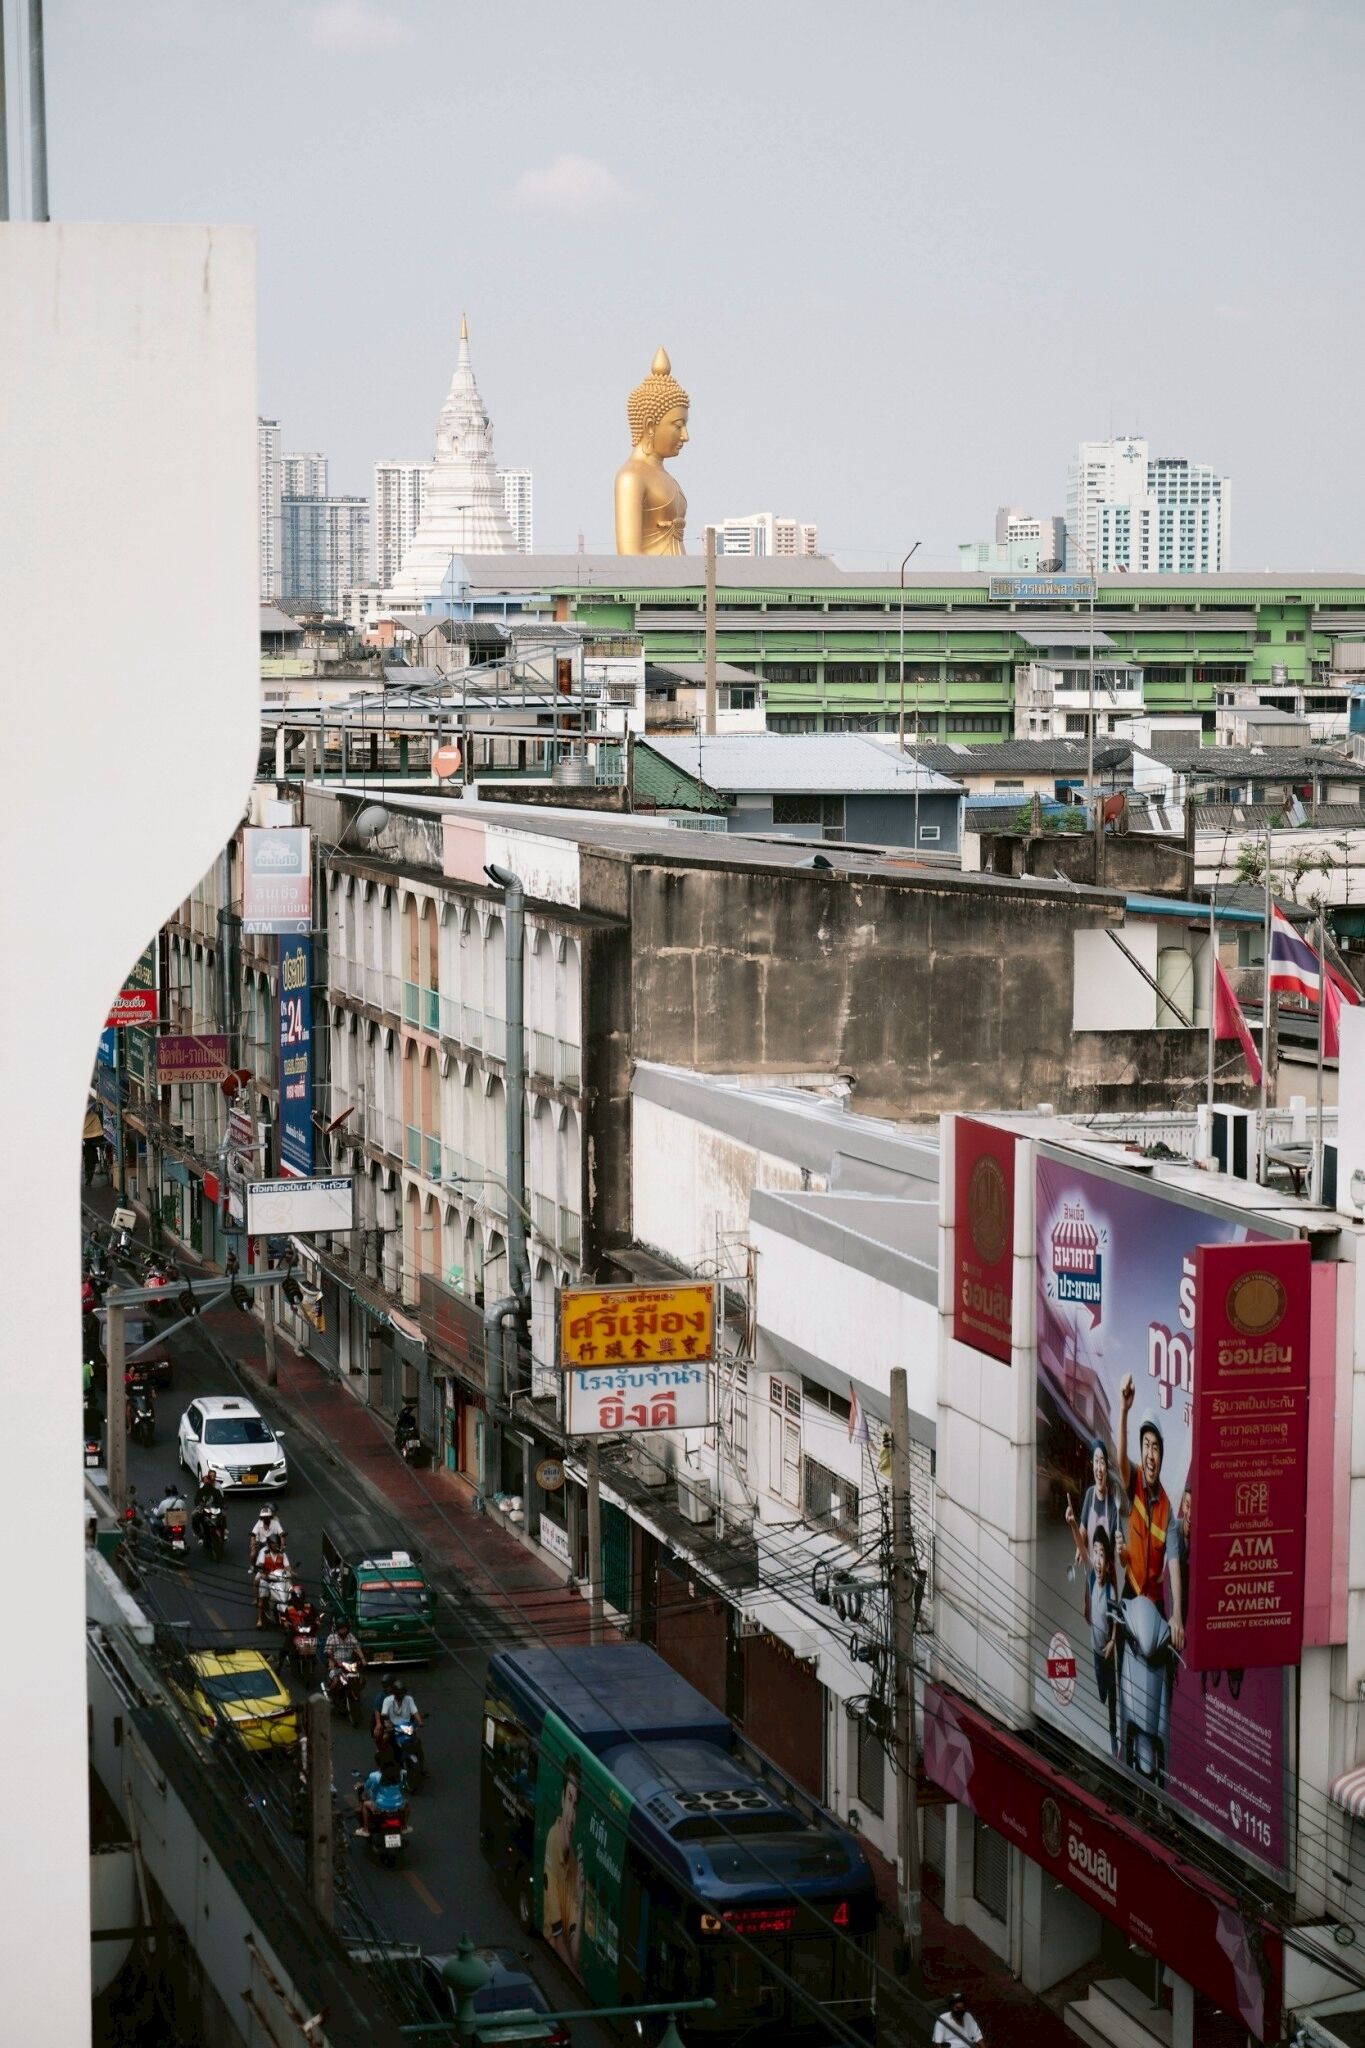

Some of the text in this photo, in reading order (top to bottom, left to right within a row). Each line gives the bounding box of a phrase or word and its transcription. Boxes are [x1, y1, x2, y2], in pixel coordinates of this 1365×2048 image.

[246, 922, 273, 932] ATM
[288, 999, 303, 1043] 24
[160, 1068, 225, 1081] 02-4663206
[1054, 1245, 1095, 1270] ธนาคาร
[1059, 1273, 1101, 1301] ประชาชน
[569, 1303, 705, 1339] ศรีเมือง
[1218, 1341, 1292, 1366] ออมสิน
[575, 1363, 702, 1391] โรงรับจำนำ
[598, 1390, 677, 1430] ยิ่งดี
[1212, 1395, 1295, 1413] รัฐบาลเป็นประกัน
[1219, 1422, 1288, 1437] สาขาตลาดพลู
[1237, 1483, 1268, 1499] GSB
[1237, 1499, 1268, 1514] LIFE
[1229, 1536, 1274, 1558] ATM
[1223, 1558, 1279, 1573] 24 HOURS
[1224, 1580, 1275, 1596] ONLINE
[1217, 1597, 1282, 1613] PAYMENT
[1206, 1616, 1292, 1631] CURRENCY EXCHANGE
[1243, 1809, 1272, 1847] 1115
[1068, 1834, 1118, 1892] ออมสิน
[833, 1901, 849, 1926] 4
